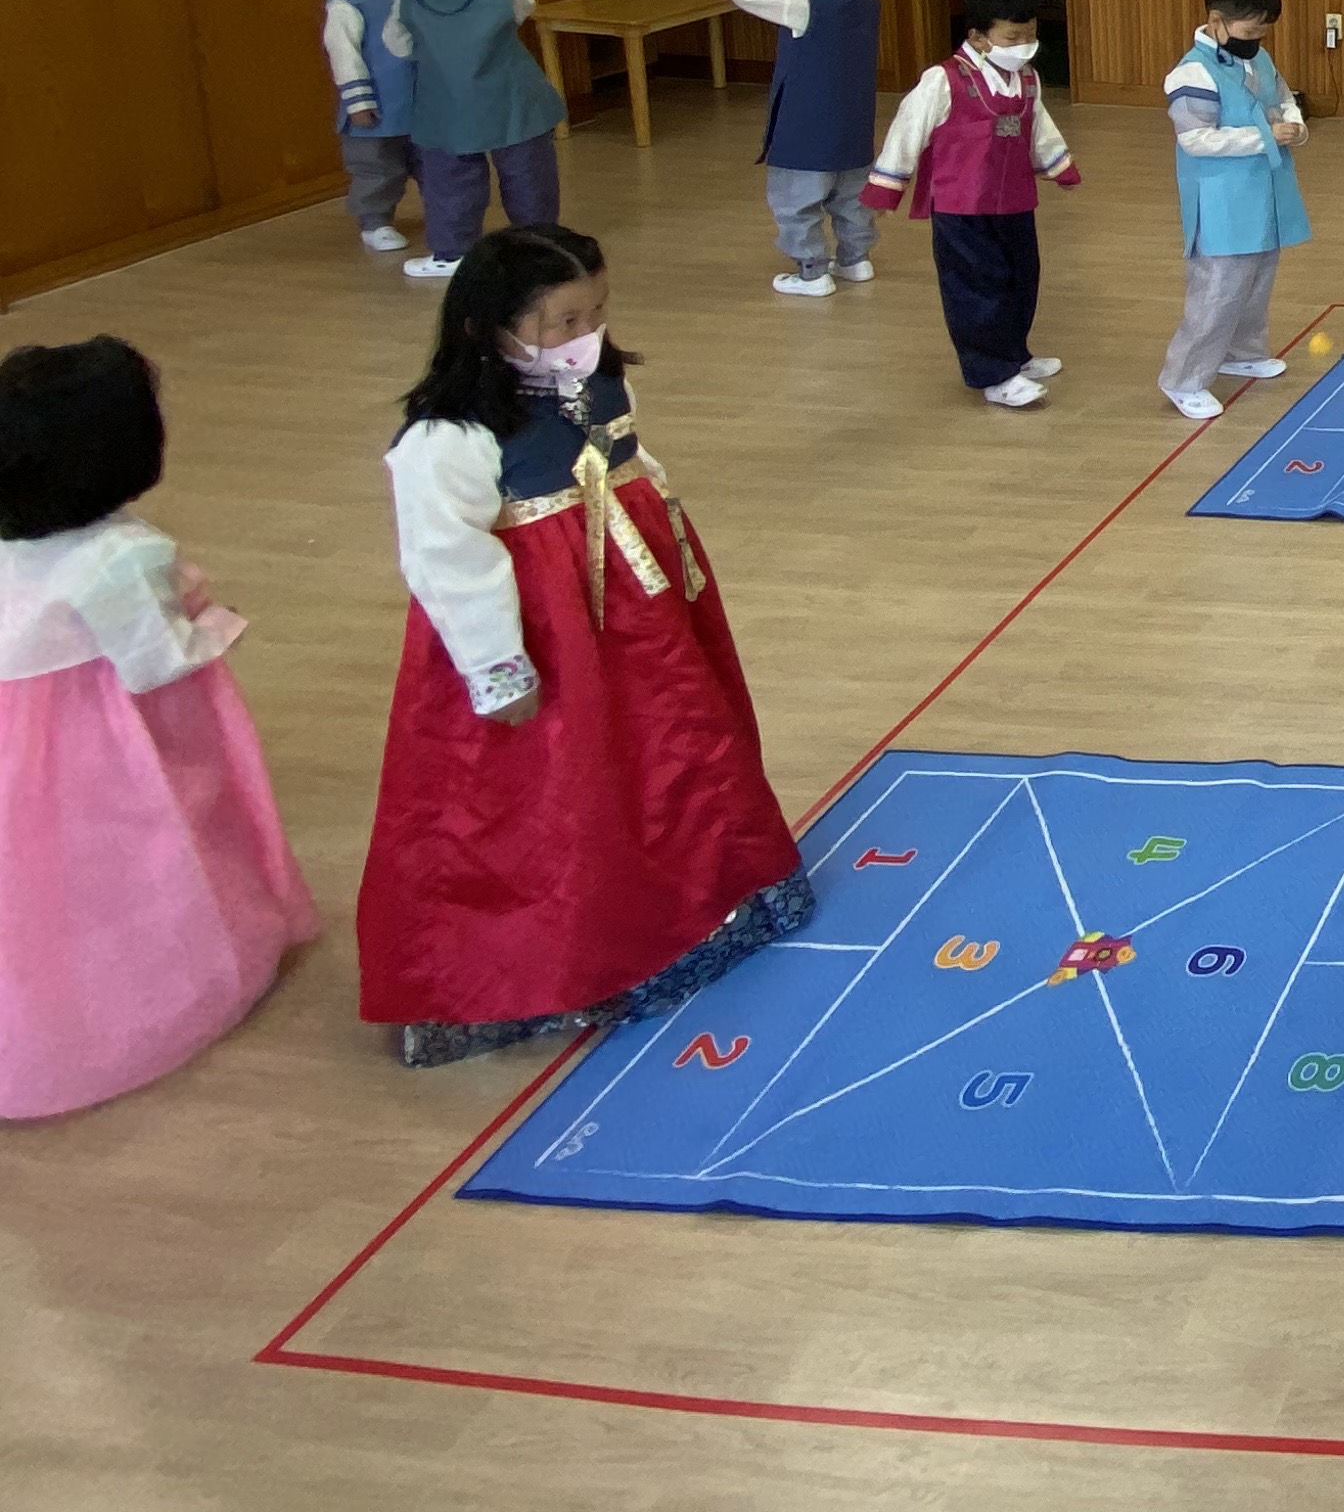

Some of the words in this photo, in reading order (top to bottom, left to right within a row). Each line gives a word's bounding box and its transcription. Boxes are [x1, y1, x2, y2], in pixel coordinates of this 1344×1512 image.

[1283, 460, 1324, 474] 2
[853, 847, 918, 870] 1
[1126, 836, 1187, 865] 4
[933, 935, 1000, 971] 3
[1186, 944, 1247, 977] 6
[672, 1032, 752, 1070] 2
[959, 1070, 1034, 1110] 5
